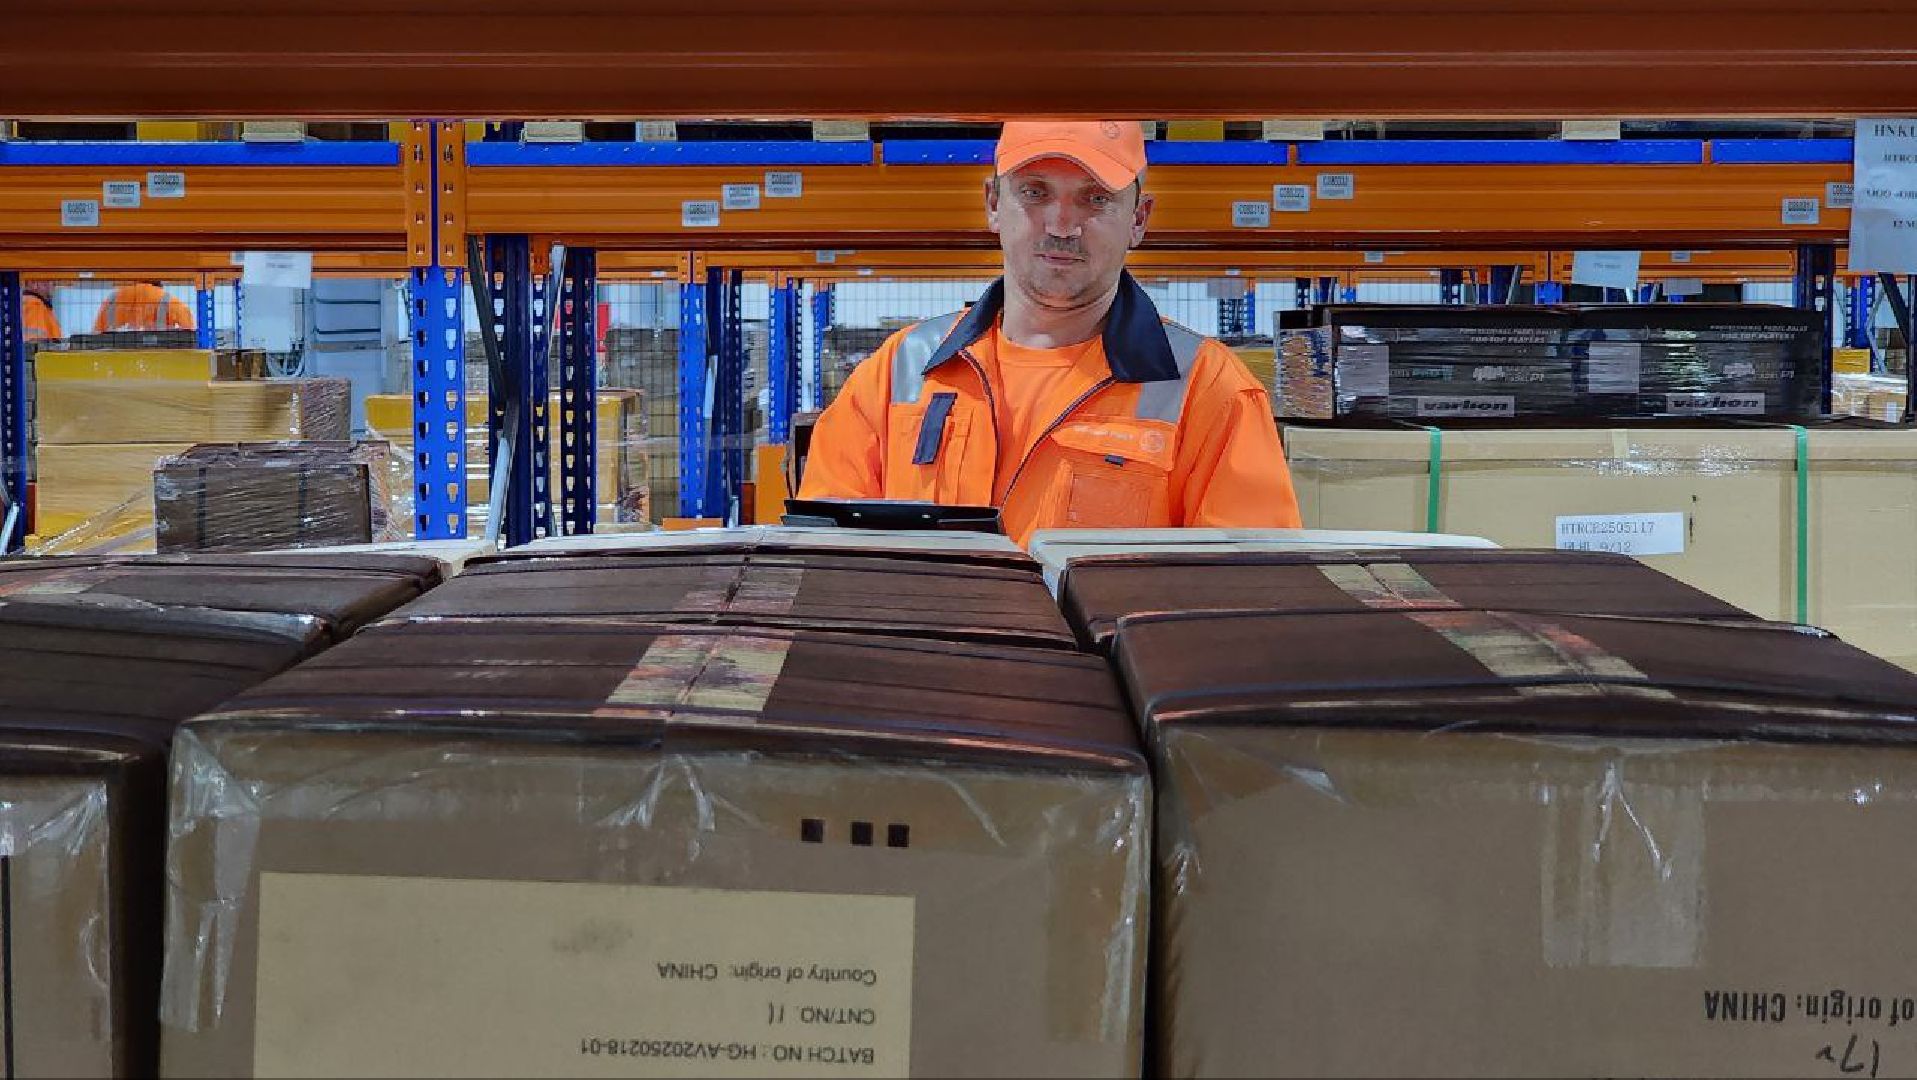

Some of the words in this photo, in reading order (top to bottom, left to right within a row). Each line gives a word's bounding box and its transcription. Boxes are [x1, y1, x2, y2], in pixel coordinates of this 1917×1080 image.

[656, 962, 719, 981] CHINA
[785, 965, 804, 984] of
[808, 963, 877, 986] Country
[1703, 990, 1787, 1024] CHINA
[1796, 989, 1882, 1026] origin:
[1887, 997, 1915, 1028] of
[808, 1046, 875, 1065] BATCH
